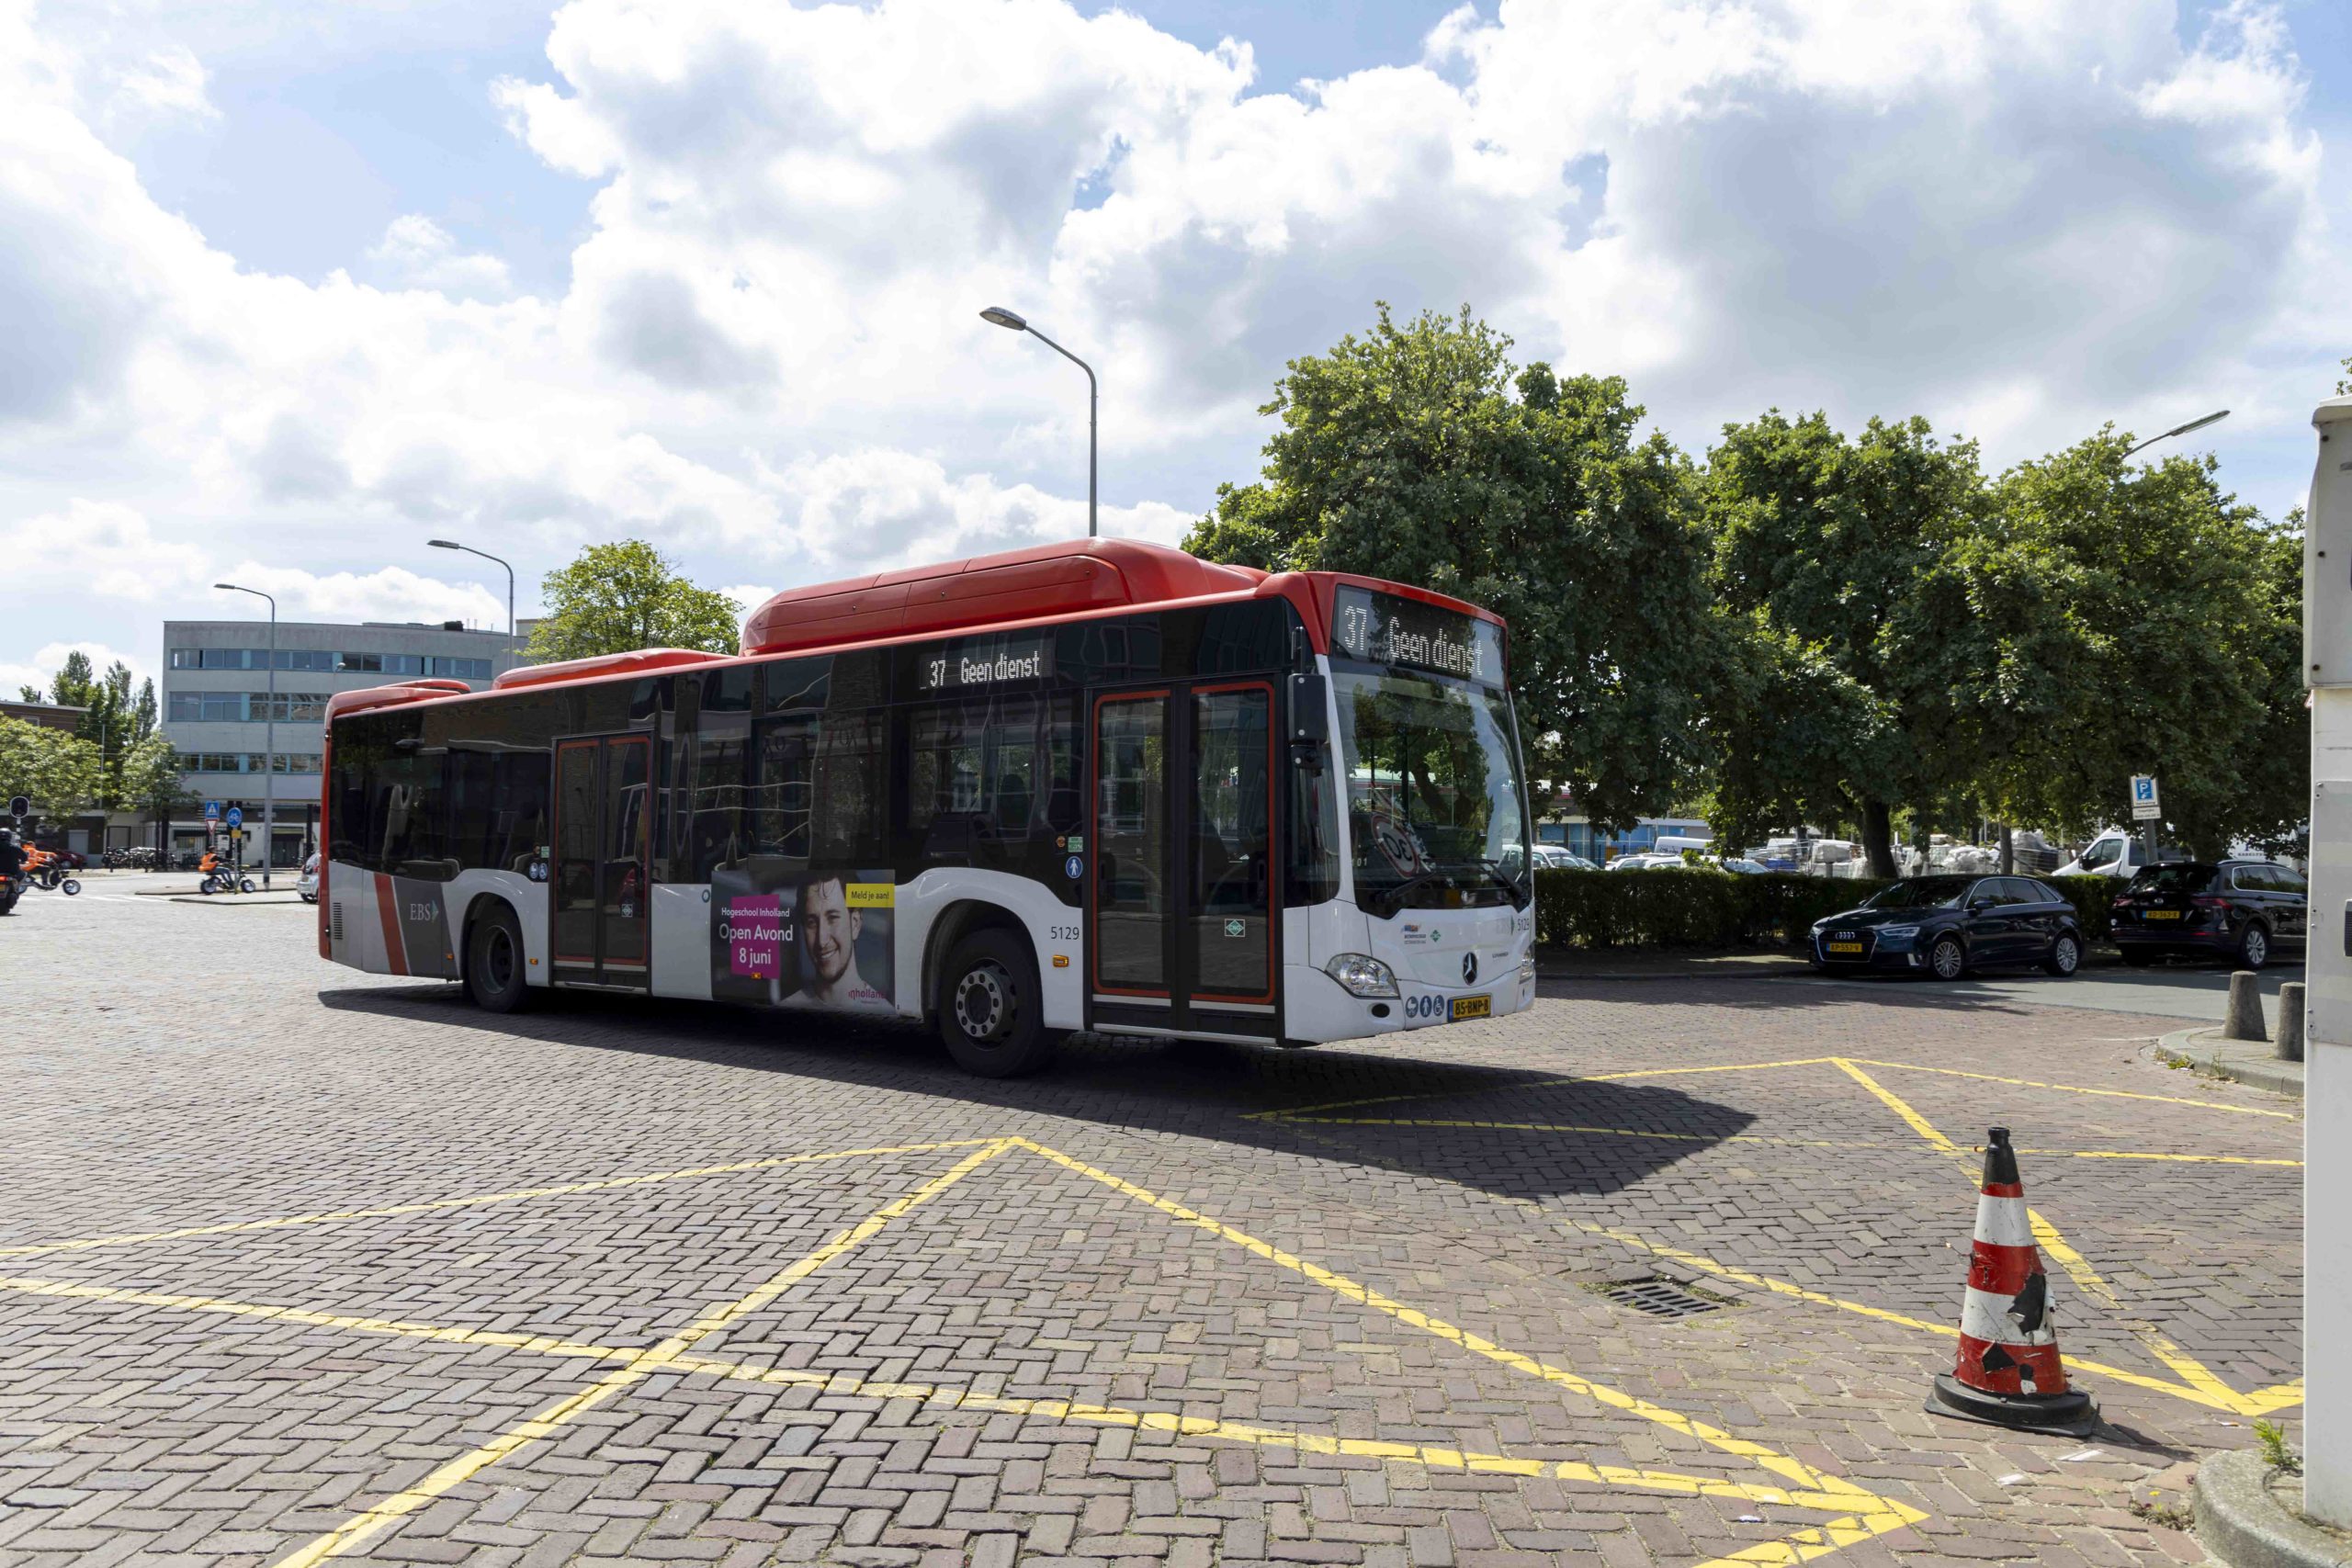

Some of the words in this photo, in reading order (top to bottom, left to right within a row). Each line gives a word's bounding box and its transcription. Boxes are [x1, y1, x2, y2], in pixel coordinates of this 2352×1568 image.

[1344, 605, 1367, 650] 37
[1389, 616, 1430, 665] Geen
[1432, 628, 1484, 676] dienst
[930, 660, 946, 687] 37
[961, 657, 992, 683] Geen
[994, 650, 1040, 681] dienst
[851, 891, 867, 899] Meld
[867, 891, 875, 900] je
[410, 903, 431, 921] EBS
[721, 907, 759, 919] Hogeschool
[759, 908, 790, 918] Inholland
[719, 923, 752, 943] Open
[753, 924, 794, 942] Avond
[1050, 926, 1080, 940] 5129
[739, 947, 747, 964] 8
[749, 948, 772, 968] juni
